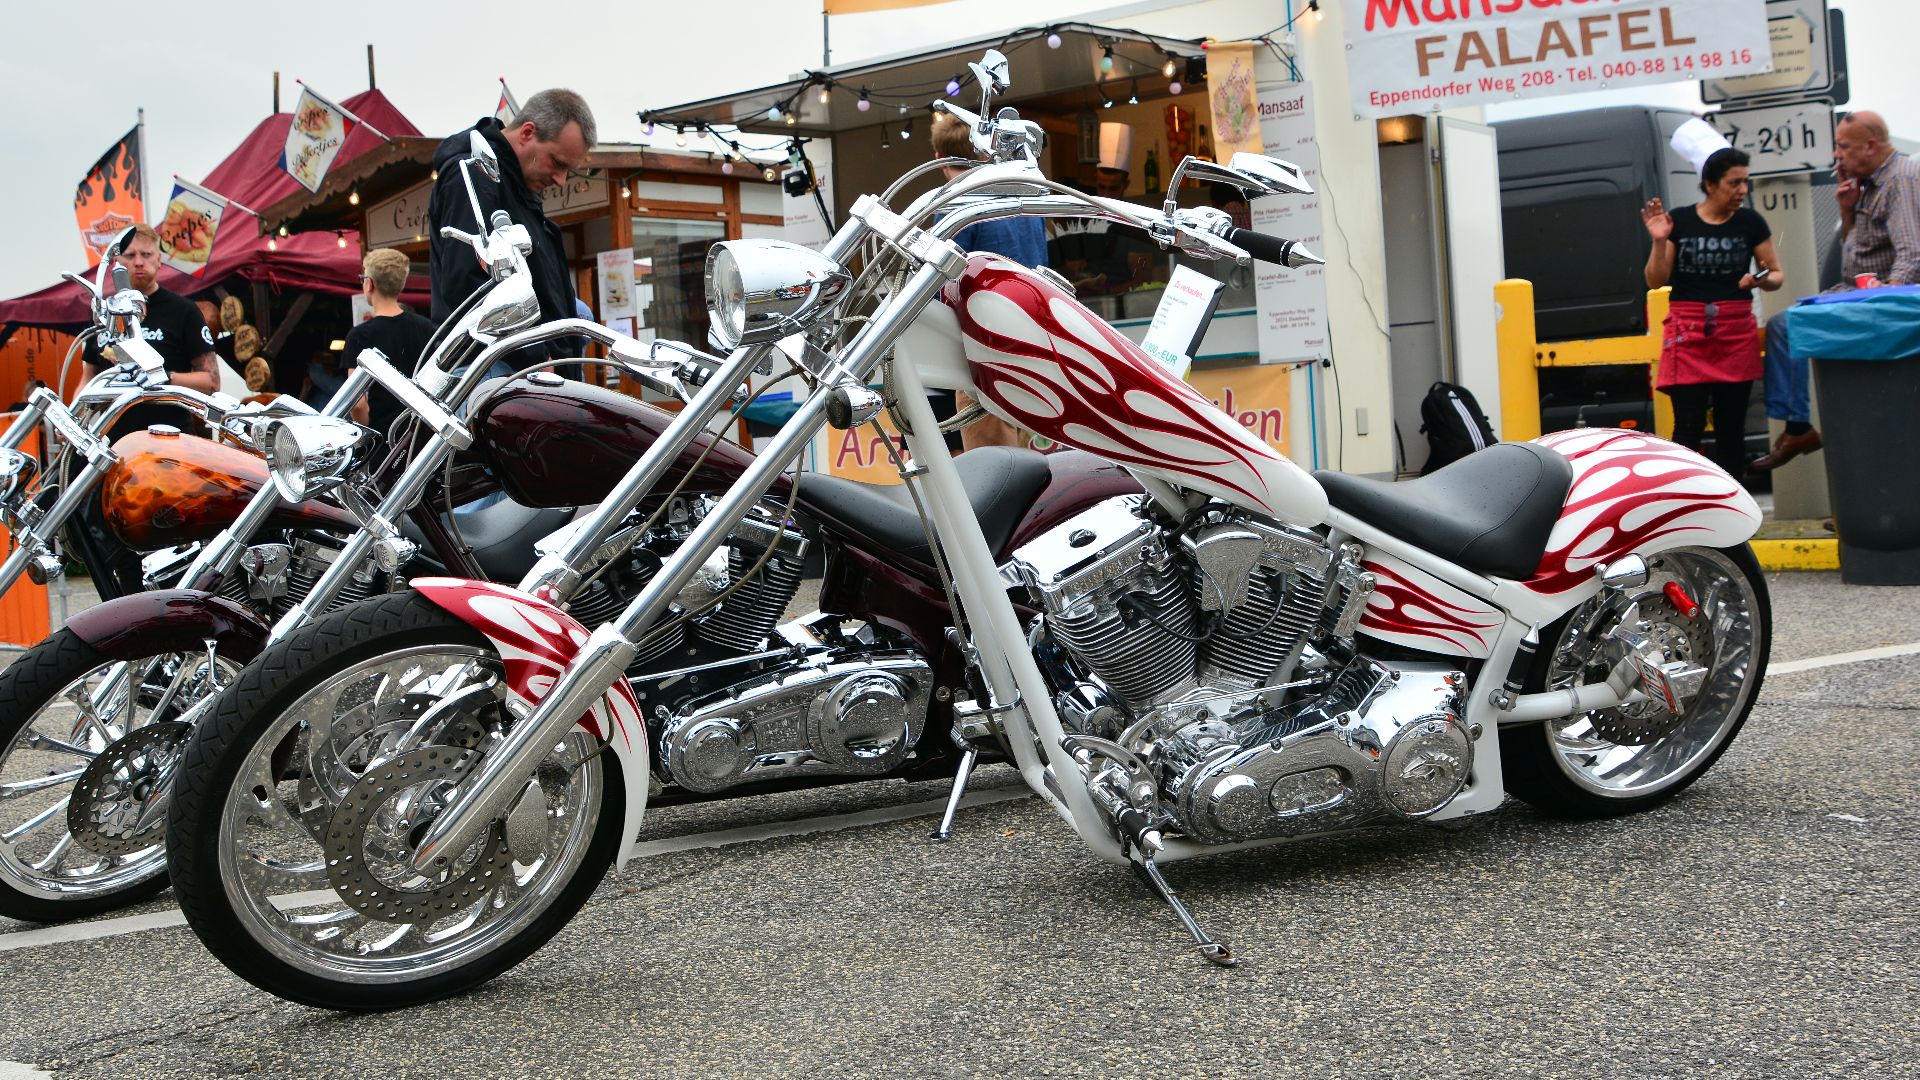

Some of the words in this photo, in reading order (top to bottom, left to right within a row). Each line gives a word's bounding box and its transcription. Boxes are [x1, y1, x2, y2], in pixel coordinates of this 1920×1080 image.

[1414, 7, 1697, 78] FALAFEL
[1369, 80, 1474, 108] Eppendorfer
[1478, 76, 1516, 94] Weg
[1521, 71, 1556, 88] 208
[1566, 65, 1597, 82] Tel.
[1602, 58, 1666, 79] 040-88
[1673, 55, 1695, 72] 14
[1700, 53, 1724, 69] 98
[1730, 48, 1753, 65] 16
[1802, 123, 1815, 149] h
[394, 198, 430, 236] Crêp
[1763, 193, 1777, 211] U
[1782, 193, 1797, 210] 11
